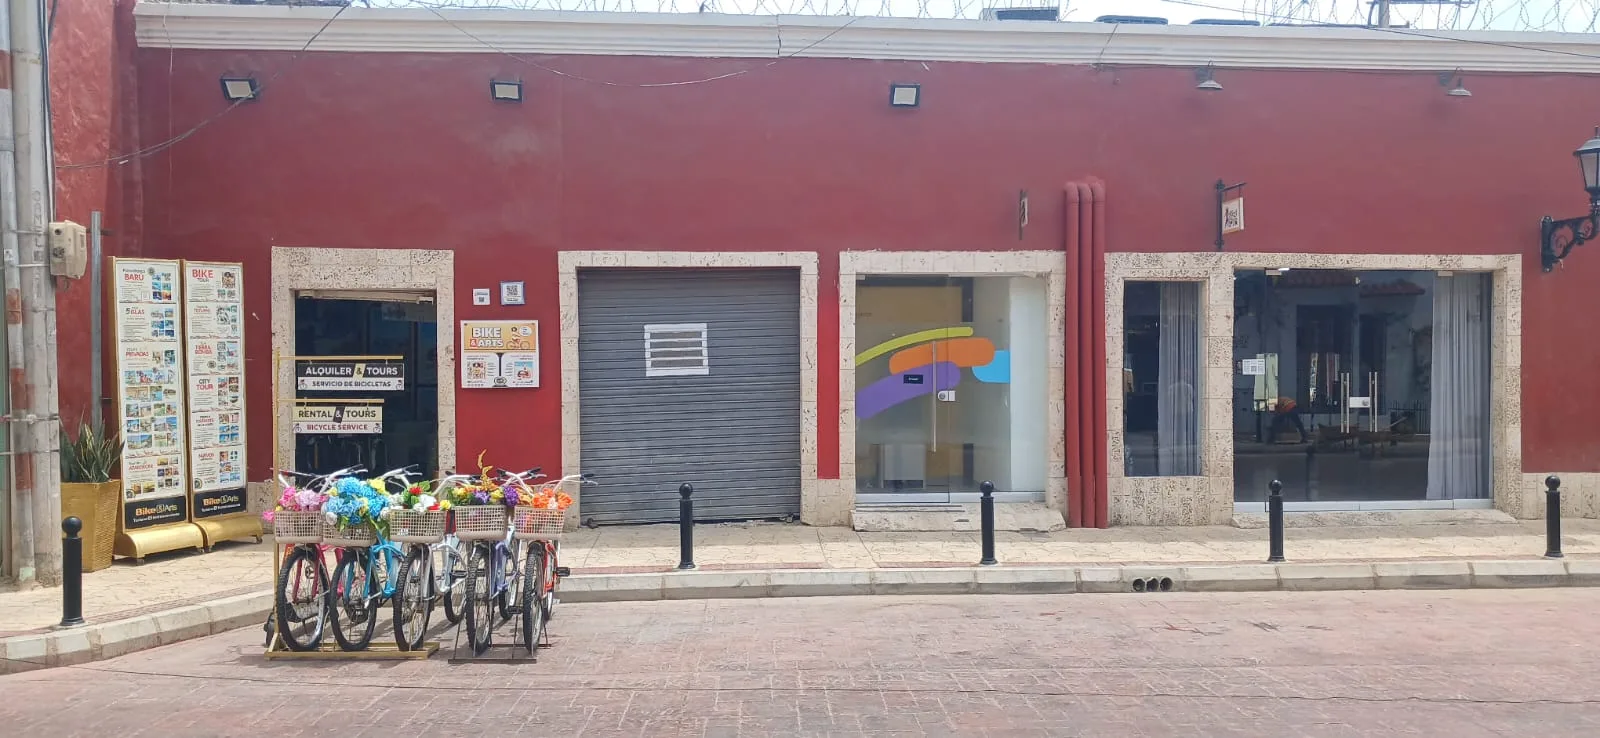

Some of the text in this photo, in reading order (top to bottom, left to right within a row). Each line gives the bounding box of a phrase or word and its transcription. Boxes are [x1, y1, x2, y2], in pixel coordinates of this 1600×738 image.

[192, 269, 214, 278] BIKE
[472, 328, 502, 338] BIKE
[478, 340, 504, 348] ARTS
[306, 367, 398, 376] ALQUILER & TOURS
[336, 410, 342, 418] &
